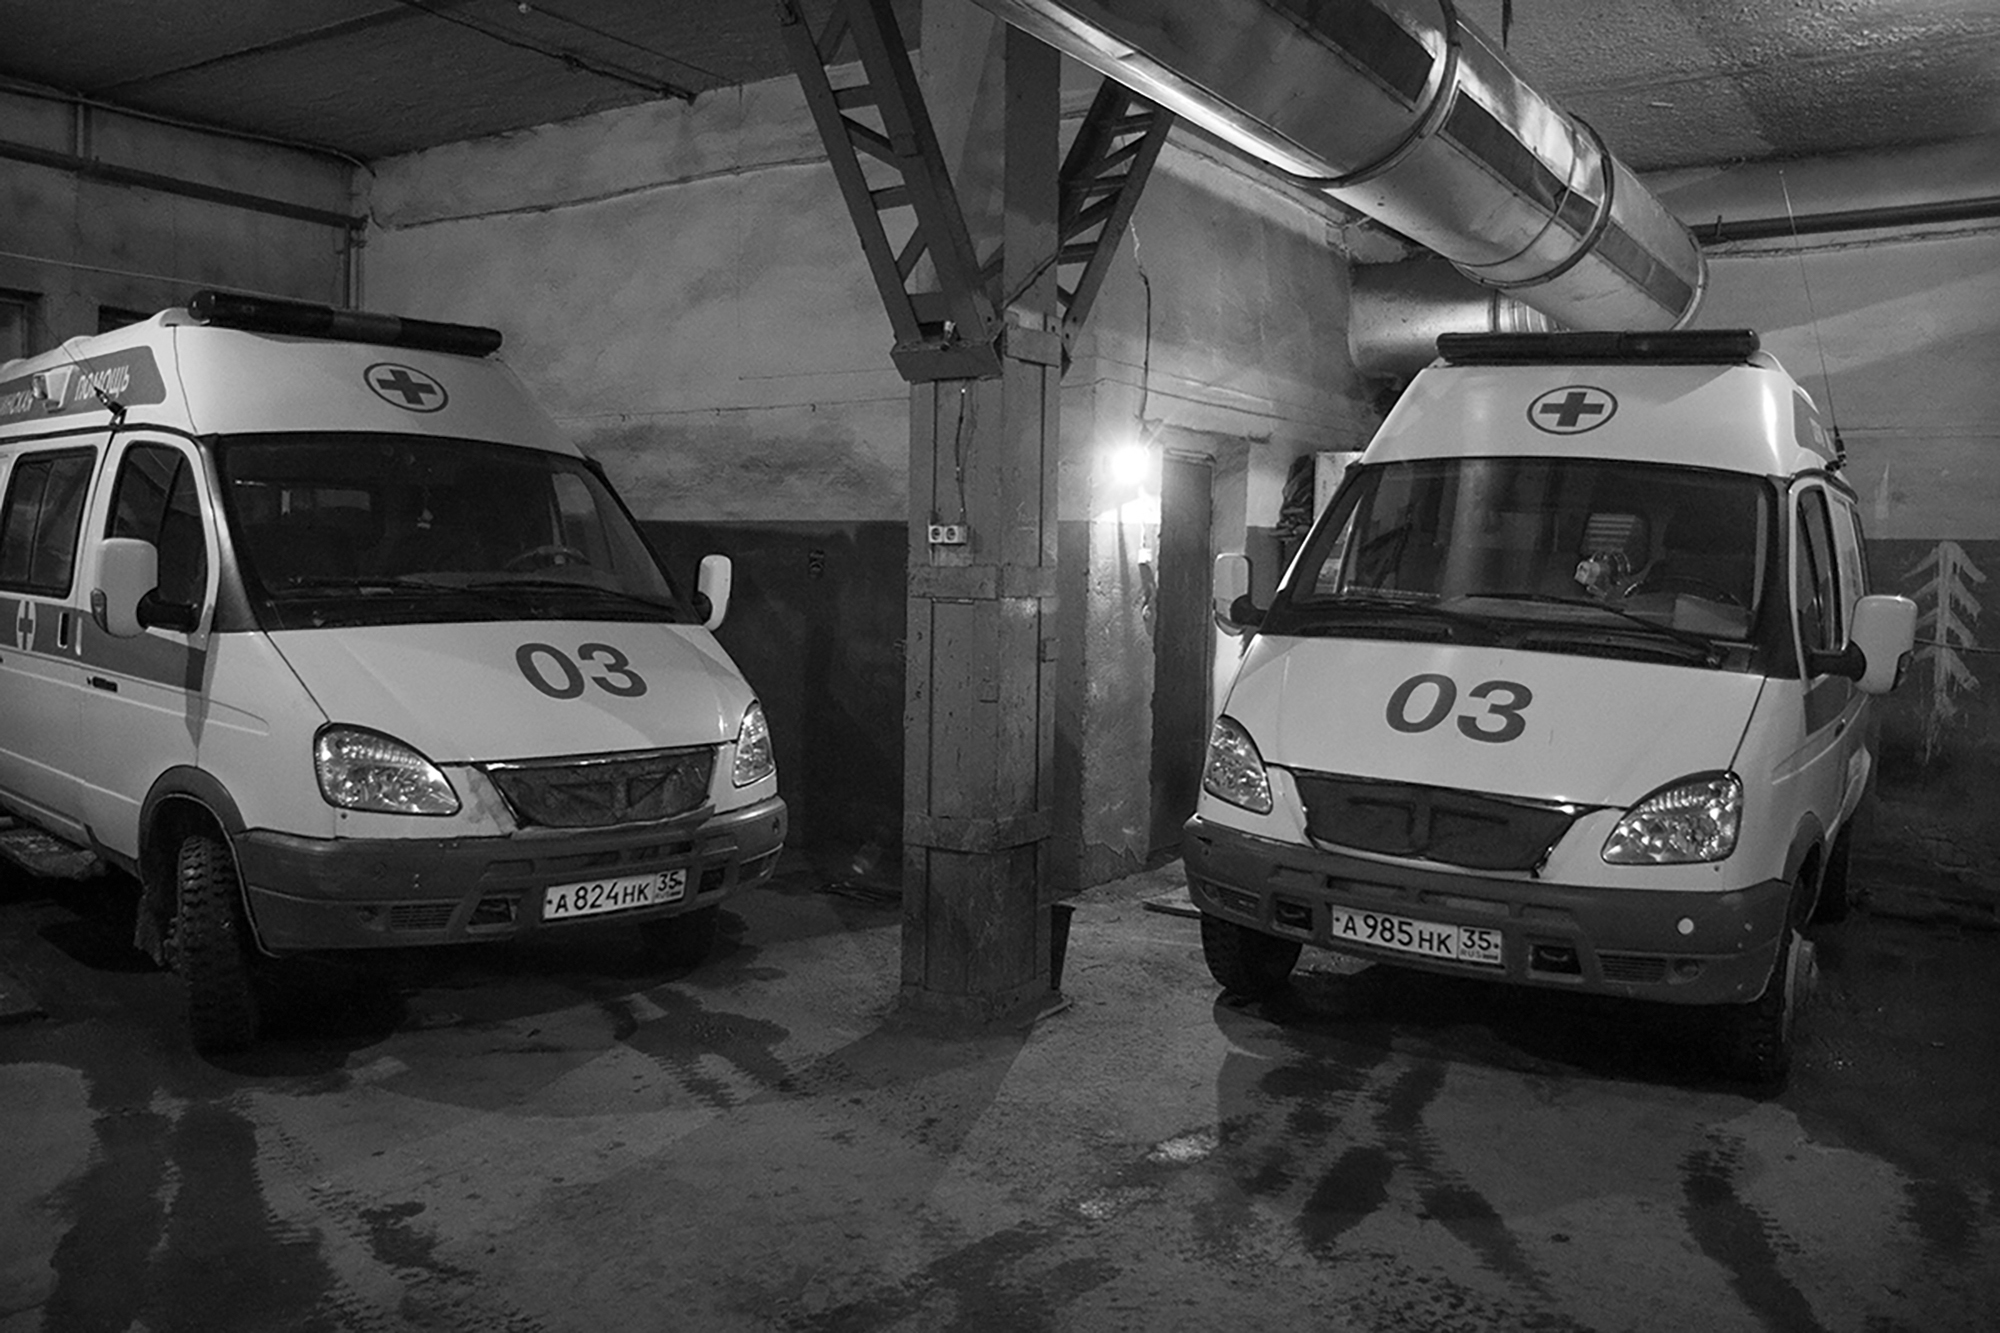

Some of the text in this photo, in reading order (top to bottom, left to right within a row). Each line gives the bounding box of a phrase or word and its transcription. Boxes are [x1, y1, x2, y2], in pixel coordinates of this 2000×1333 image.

[516, 642, 648, 700] 03
[1386, 673, 1533, 743] 03
[657, 871, 679, 892] 35
[1462, 928, 1492, 951] 35
